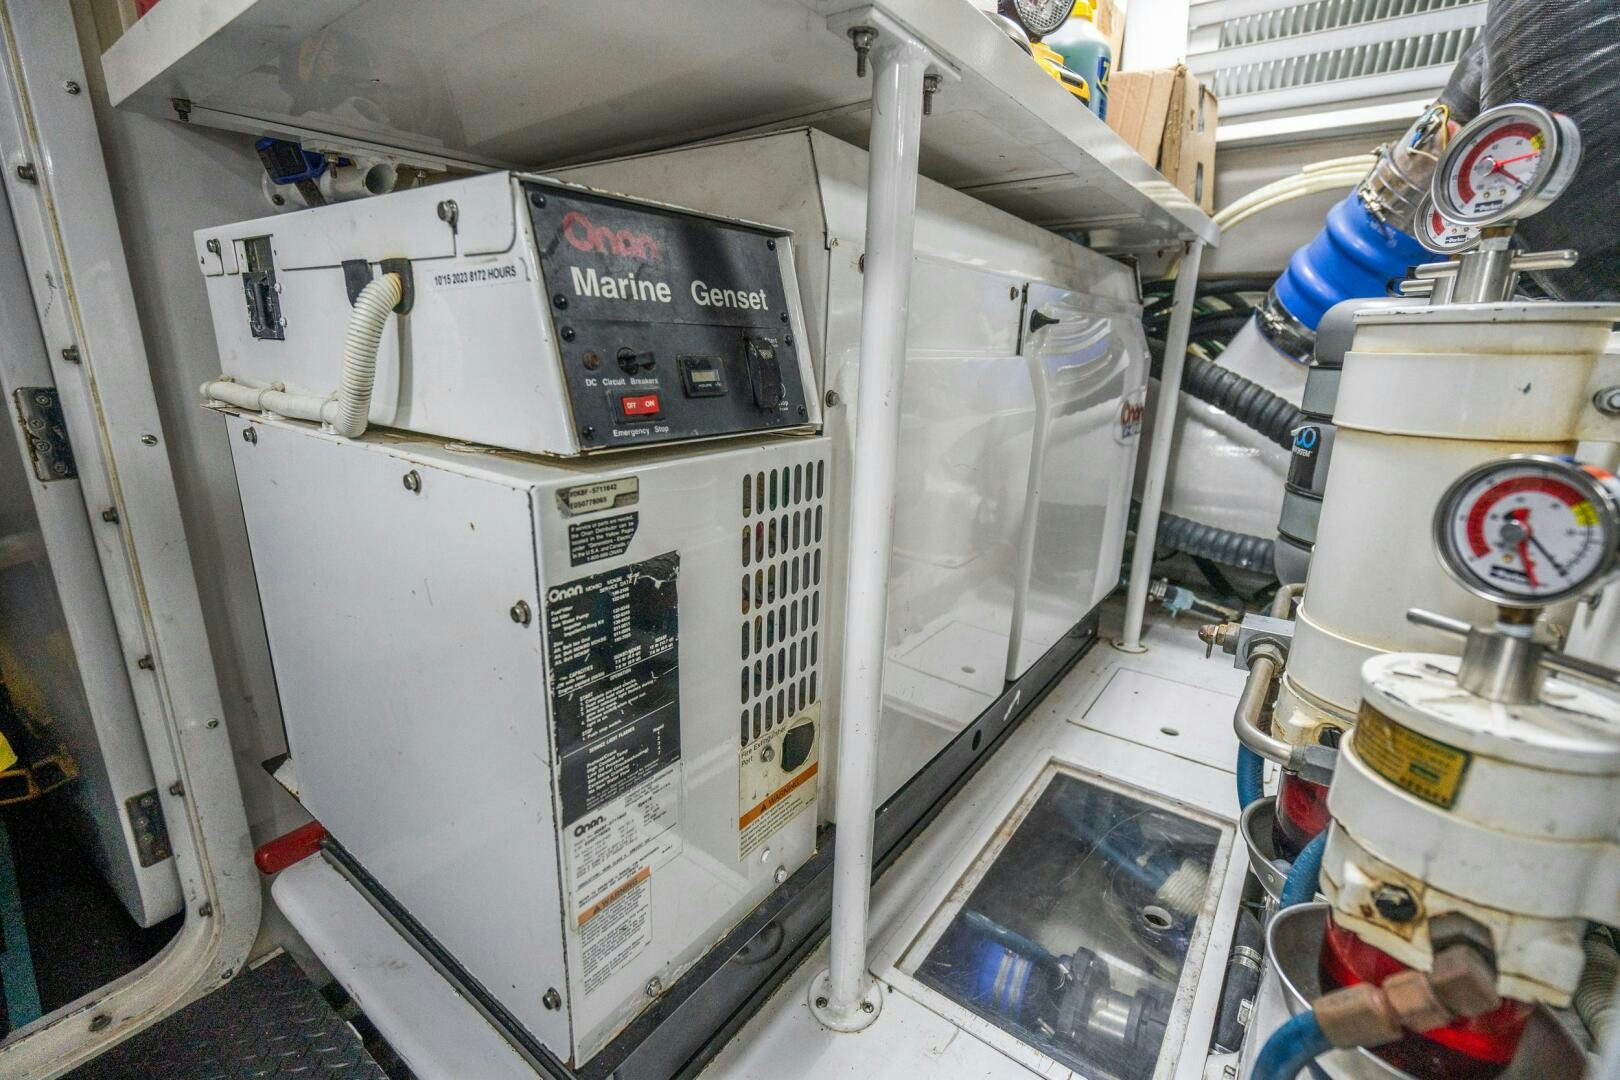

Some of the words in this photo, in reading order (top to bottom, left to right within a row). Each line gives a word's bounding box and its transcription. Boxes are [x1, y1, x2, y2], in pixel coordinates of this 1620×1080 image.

[452, 272, 468, 284] 2023
[470, 269, 486, 282] 8172
[488, 265, 517, 280] HOURS
[570, 266, 672, 303] Marine
[690, 280, 769, 311] Genset
[586, 378, 598, 386] DC
[630, 377, 660, 385] Breakers
[613, 427, 650, 437] Emergency
[548, 585, 584, 603] Onan
[741, 748, 752, 759] Fire
[742, 756, 753, 768] Port
[768, 778, 800, 807] WARNING
[574, 816, 604, 838] Onan
